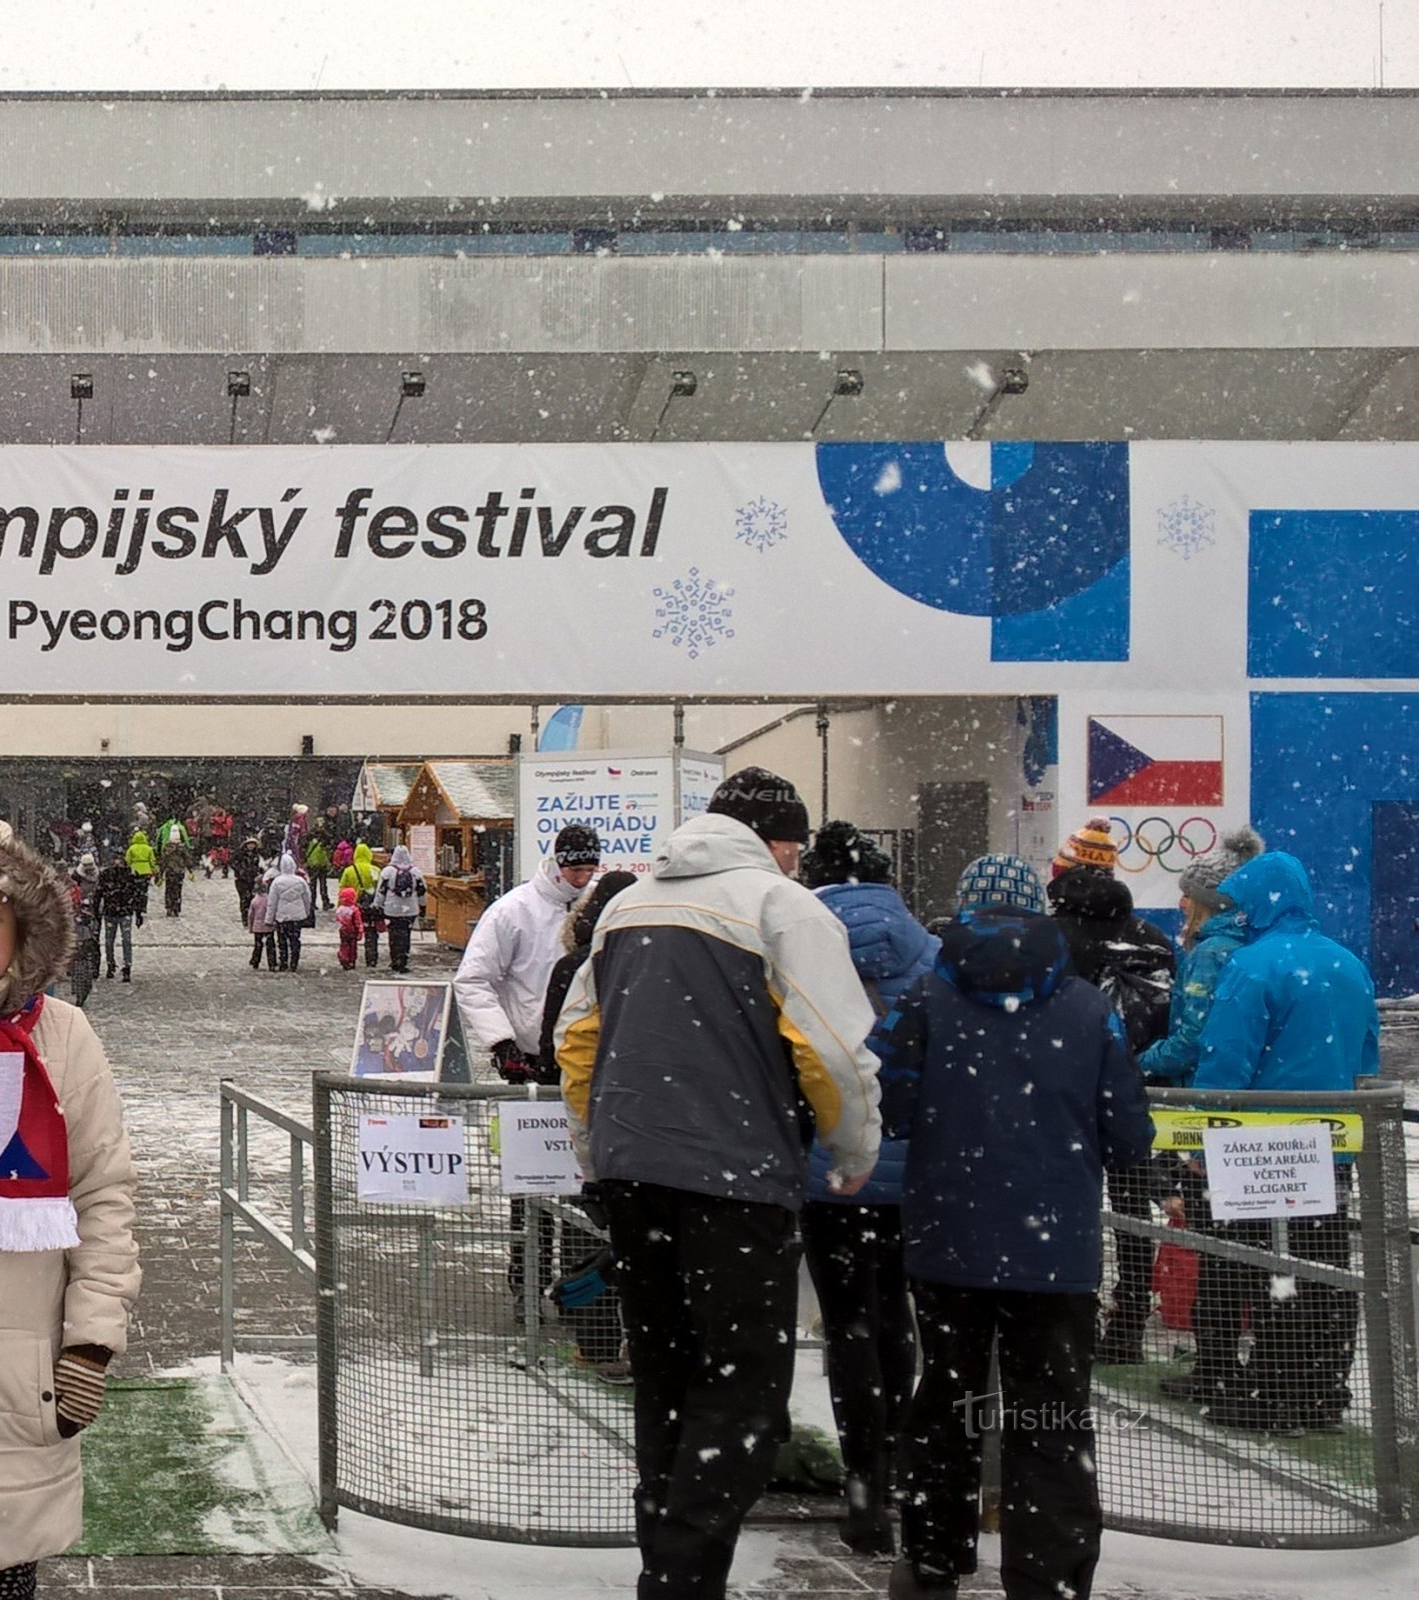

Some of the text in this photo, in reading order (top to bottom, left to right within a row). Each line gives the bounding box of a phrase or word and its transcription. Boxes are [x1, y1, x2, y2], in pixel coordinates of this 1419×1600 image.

[333, 487, 669, 559] festival
[8, 599, 488, 652] PyeongChang 2018
[537, 792, 620, 812] ZAŽIJTE
[537, 840, 551, 855] V
[517, 1118, 569, 1131] JEDNOR
[1172, 1131, 1204, 1146] JOHNN
[1223, 1142, 1263, 1154] ZÁKAZ
[360, 1145, 462, 1175] VÝSTUP
[1223, 1158, 1232, 1167] V
